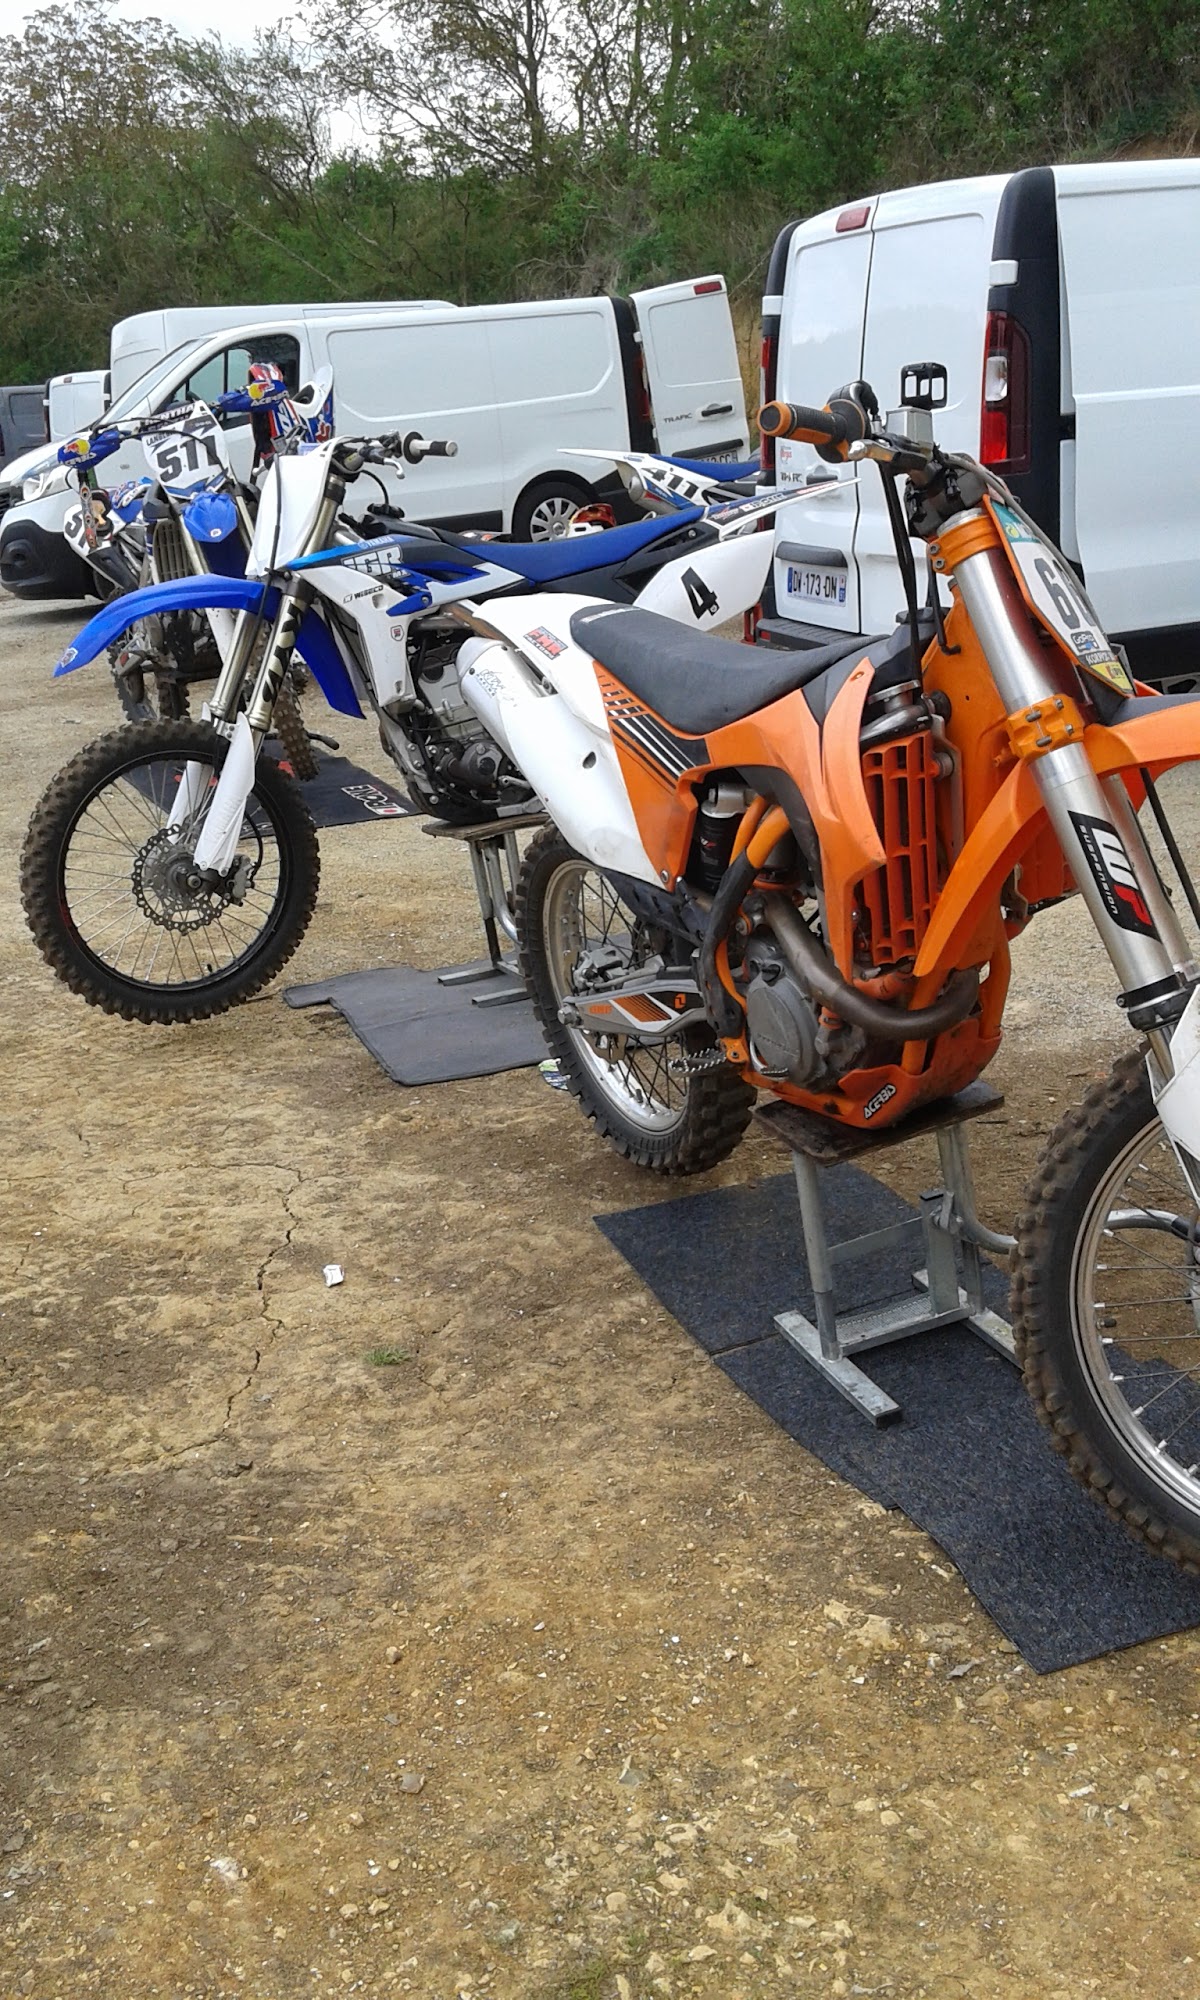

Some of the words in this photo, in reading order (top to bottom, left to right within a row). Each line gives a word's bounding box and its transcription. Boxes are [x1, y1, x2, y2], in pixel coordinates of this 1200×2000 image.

[664, 412, 693, 424] TRAFIC
[680, 566, 719, 620] 4
[1079, 824, 1119, 915] SUSPENSION
[1091, 827, 1153, 927] WP
